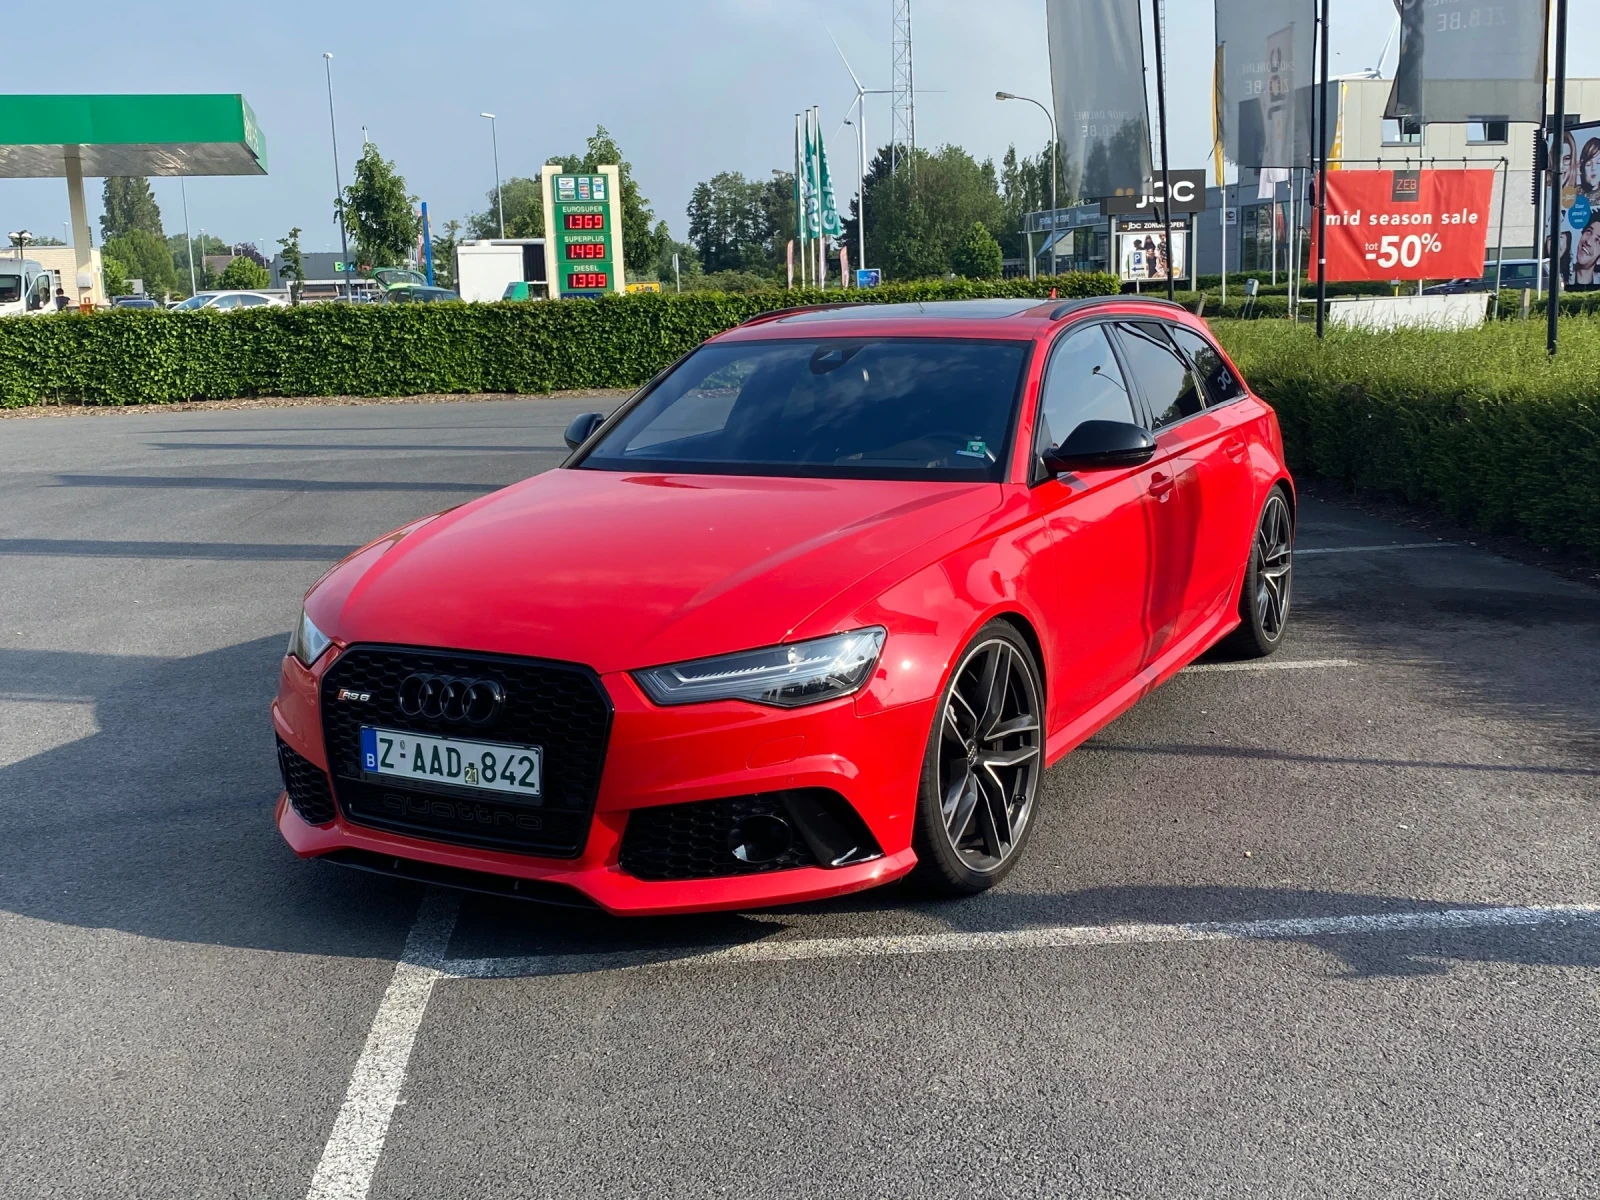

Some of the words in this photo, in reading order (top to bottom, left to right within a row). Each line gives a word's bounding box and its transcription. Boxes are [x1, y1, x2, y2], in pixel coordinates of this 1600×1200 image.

[1396, 178, 1417, 190] ZEB
[562, 205, 603, 213] EUROSUPER
[1326, 210, 1361, 225] mid
[1369, 213, 1432, 225] season
[1441, 208, 1478, 224] sale
[1127, 221, 1141, 230] jbc
[564, 235, 605, 243] SUPERPLUS
[1365, 243, 1379, 251] tot
[1365, 233, 1442, 268] -50%
[1134, 254, 1141, 263] P
[366, 753, 375, 767] B
[383, 793, 542, 830] quattro
